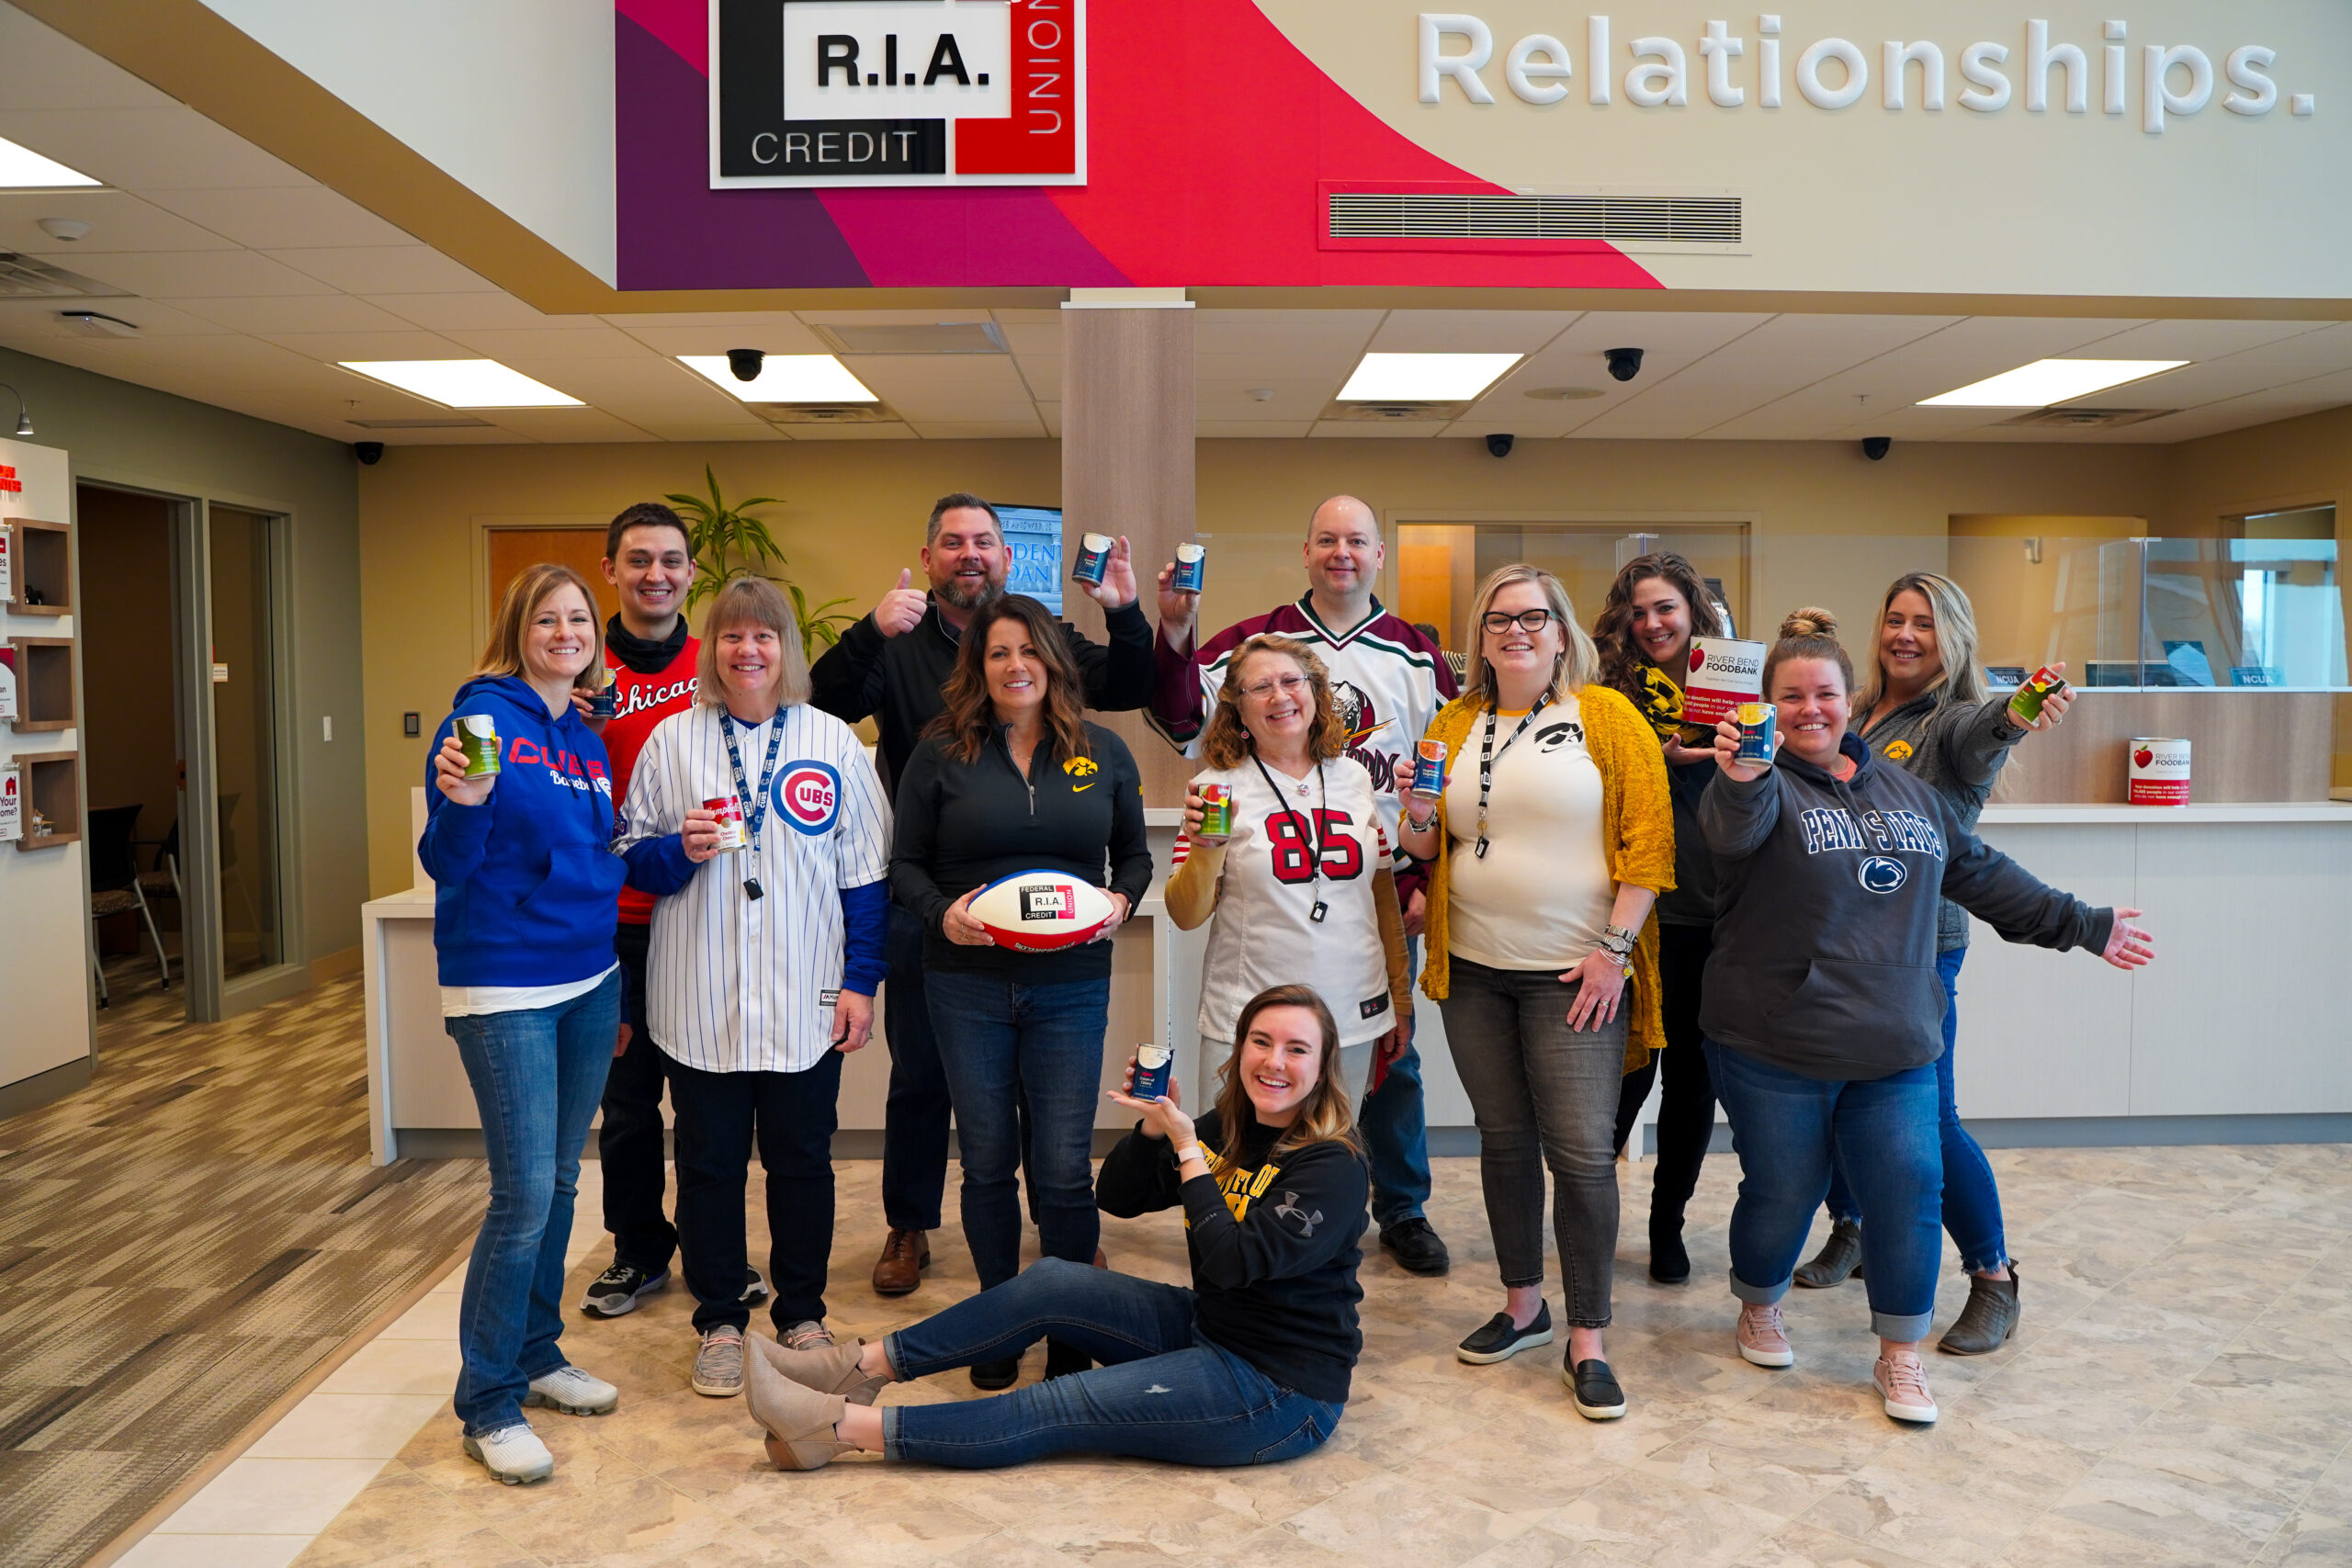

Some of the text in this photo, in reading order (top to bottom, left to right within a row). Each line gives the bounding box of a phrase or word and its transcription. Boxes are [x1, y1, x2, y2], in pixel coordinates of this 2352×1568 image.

[817, 33, 989, 87] R.I.A.
[1418, 13, 2315, 134] Relationships.
[752, 130, 918, 164] CREDIT
[1006, 542, 1062, 561] DENT
[1007, 563, 1049, 581] OAN
[1706, 663, 1758, 675] FOODBANK
[1707, 654, 1759, 668] RIVER BEND
[1996, 675, 2020, 684] NCUA
[2242, 675, 2275, 684] NCUA
[615, 677, 701, 720] hicag
[508, 737, 606, 780] CUBS
[785, 771, 834, 822] CUBS
[0, 807, 17, 818] ome?
[1264, 807, 1363, 885] 85
[1862, 810, 1943, 862] STATE
[1035, 897, 1062, 906] R.I.A.
[1066, 889, 1074, 914] UNION
[1025, 911, 1053, 919] CREDIT
